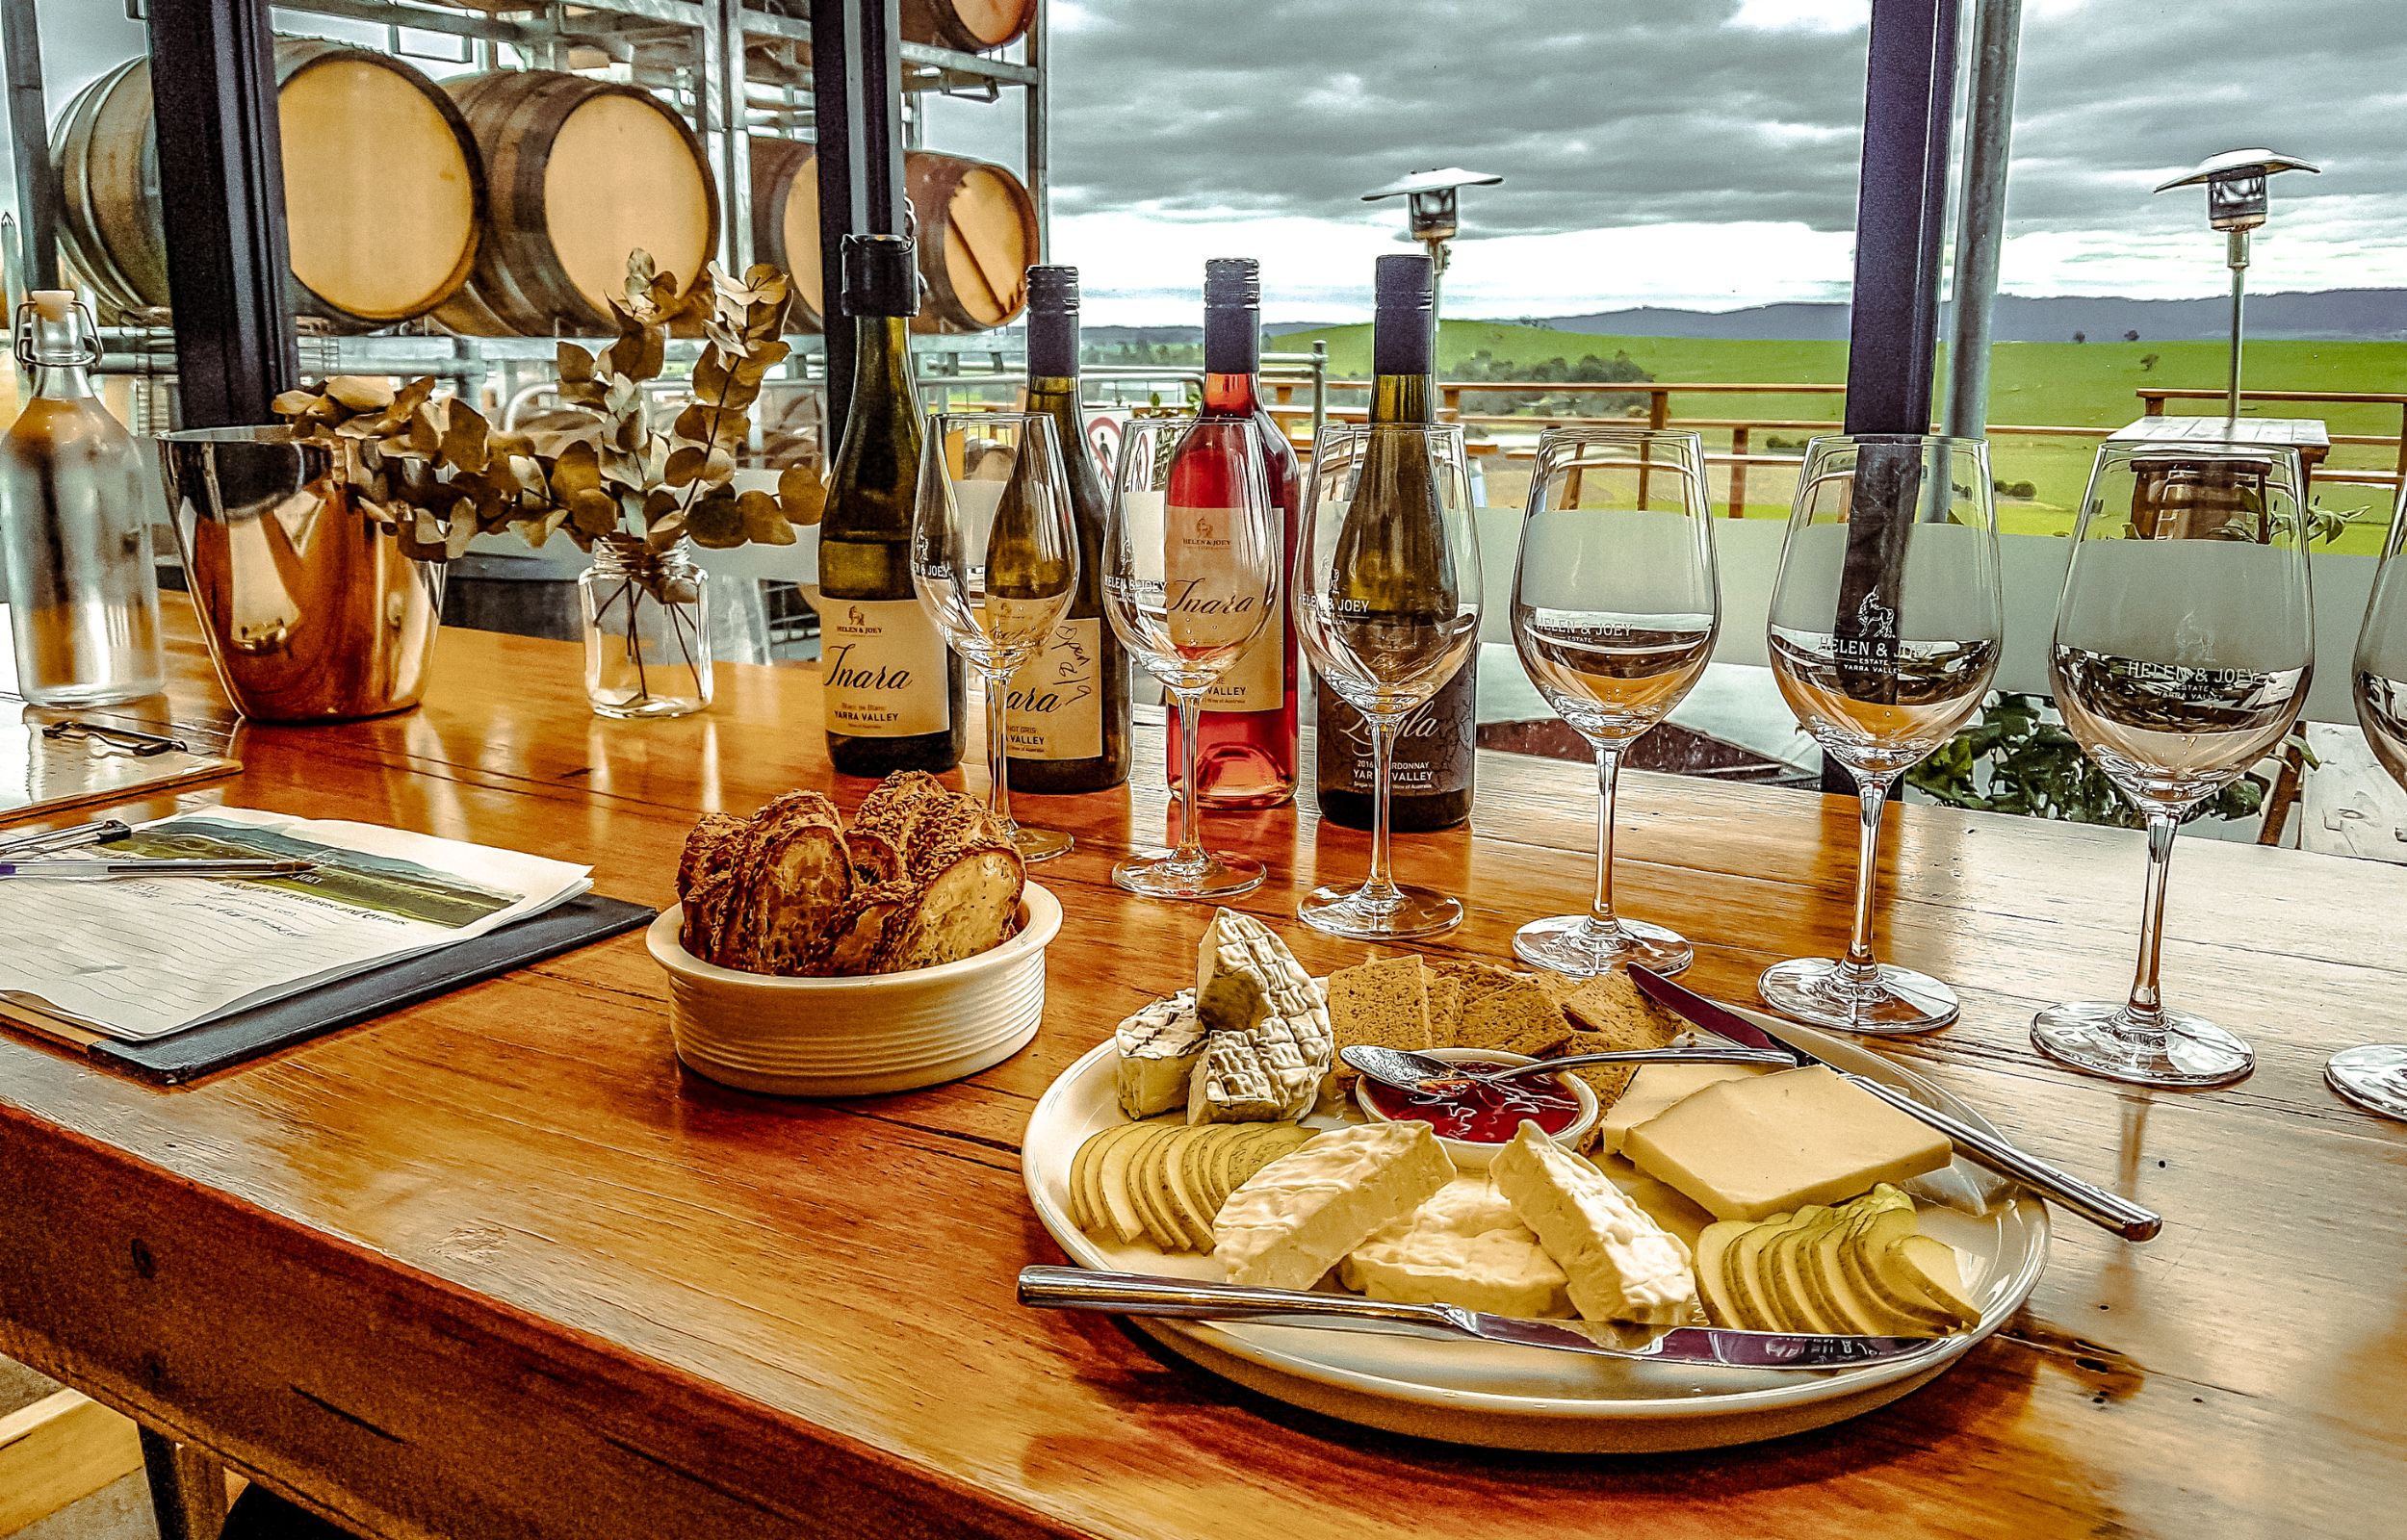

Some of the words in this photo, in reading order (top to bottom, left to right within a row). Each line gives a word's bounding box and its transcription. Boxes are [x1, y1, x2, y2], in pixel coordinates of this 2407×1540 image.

[927, 565, 949, 578] JOEY
[1169, 578, 1255, 615] Inara
[1337, 599, 1370, 613] JOEY
[1537, 617, 1576, 634] HELEN
[1580, 622, 1592, 635] &
[1595, 623, 1633, 636] JOEY
[1567, 635, 1594, 644] ESTATE
[1820, 636, 1870, 656] HELEN
[1876, 642, 1888, 657] &
[1894, 643, 1934, 659] JOEY
[824, 643, 914, 690] Inara
[1844, 664, 1870, 673] YARRA
[1873, 665, 1902, 675] VALLEY
[2128, 661, 2188, 682] HELEN
[2194, 667, 2209, 682] &
[2214, 668, 2257, 684] JOEY
[1207, 686, 1247, 696] VALLEY
[1005, 687, 1063, 713] ara
[834, 710, 860, 721] YARRA
[862, 712, 899, 722] VALLEY
[1010, 734, 1045, 745] VALLEY
[1357, 759, 1374, 769] 2016
[1391, 761, 1431, 770] RDONNAY
[1353, 769, 1374, 780] YAR
[1390, 771, 1434, 782] VALLEY
